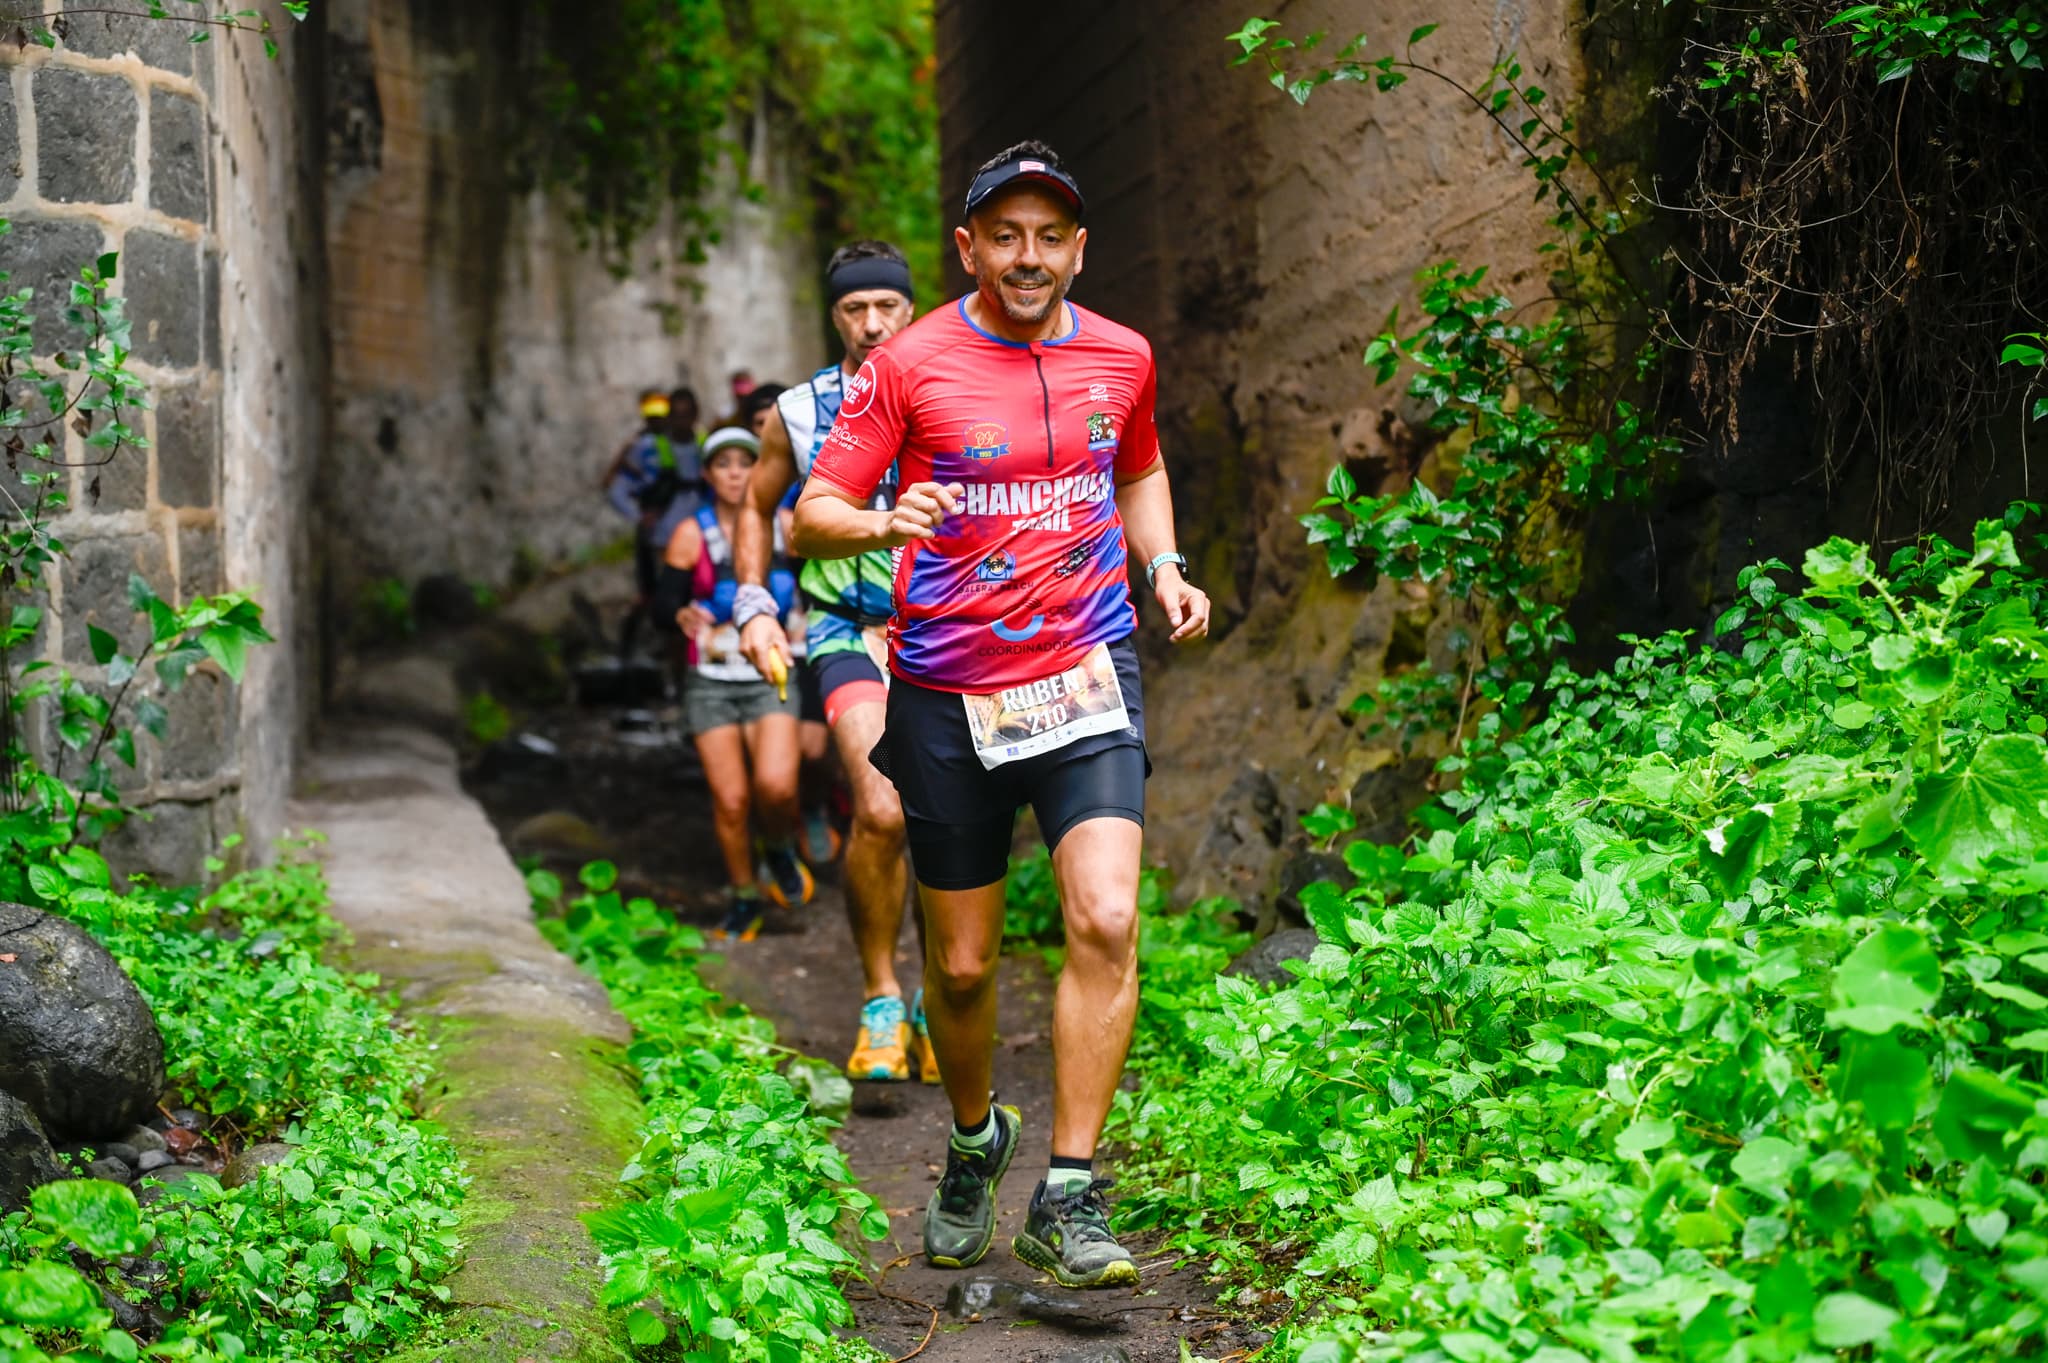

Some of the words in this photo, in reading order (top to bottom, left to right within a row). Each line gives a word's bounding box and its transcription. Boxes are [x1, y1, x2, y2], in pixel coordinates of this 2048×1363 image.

[1010, 507, 1072, 534] TRAIL
[1000, 581, 1034, 592] BEACH
[1001, 670, 1081, 714] RUBEN
[1027, 703, 1067, 736] 210
